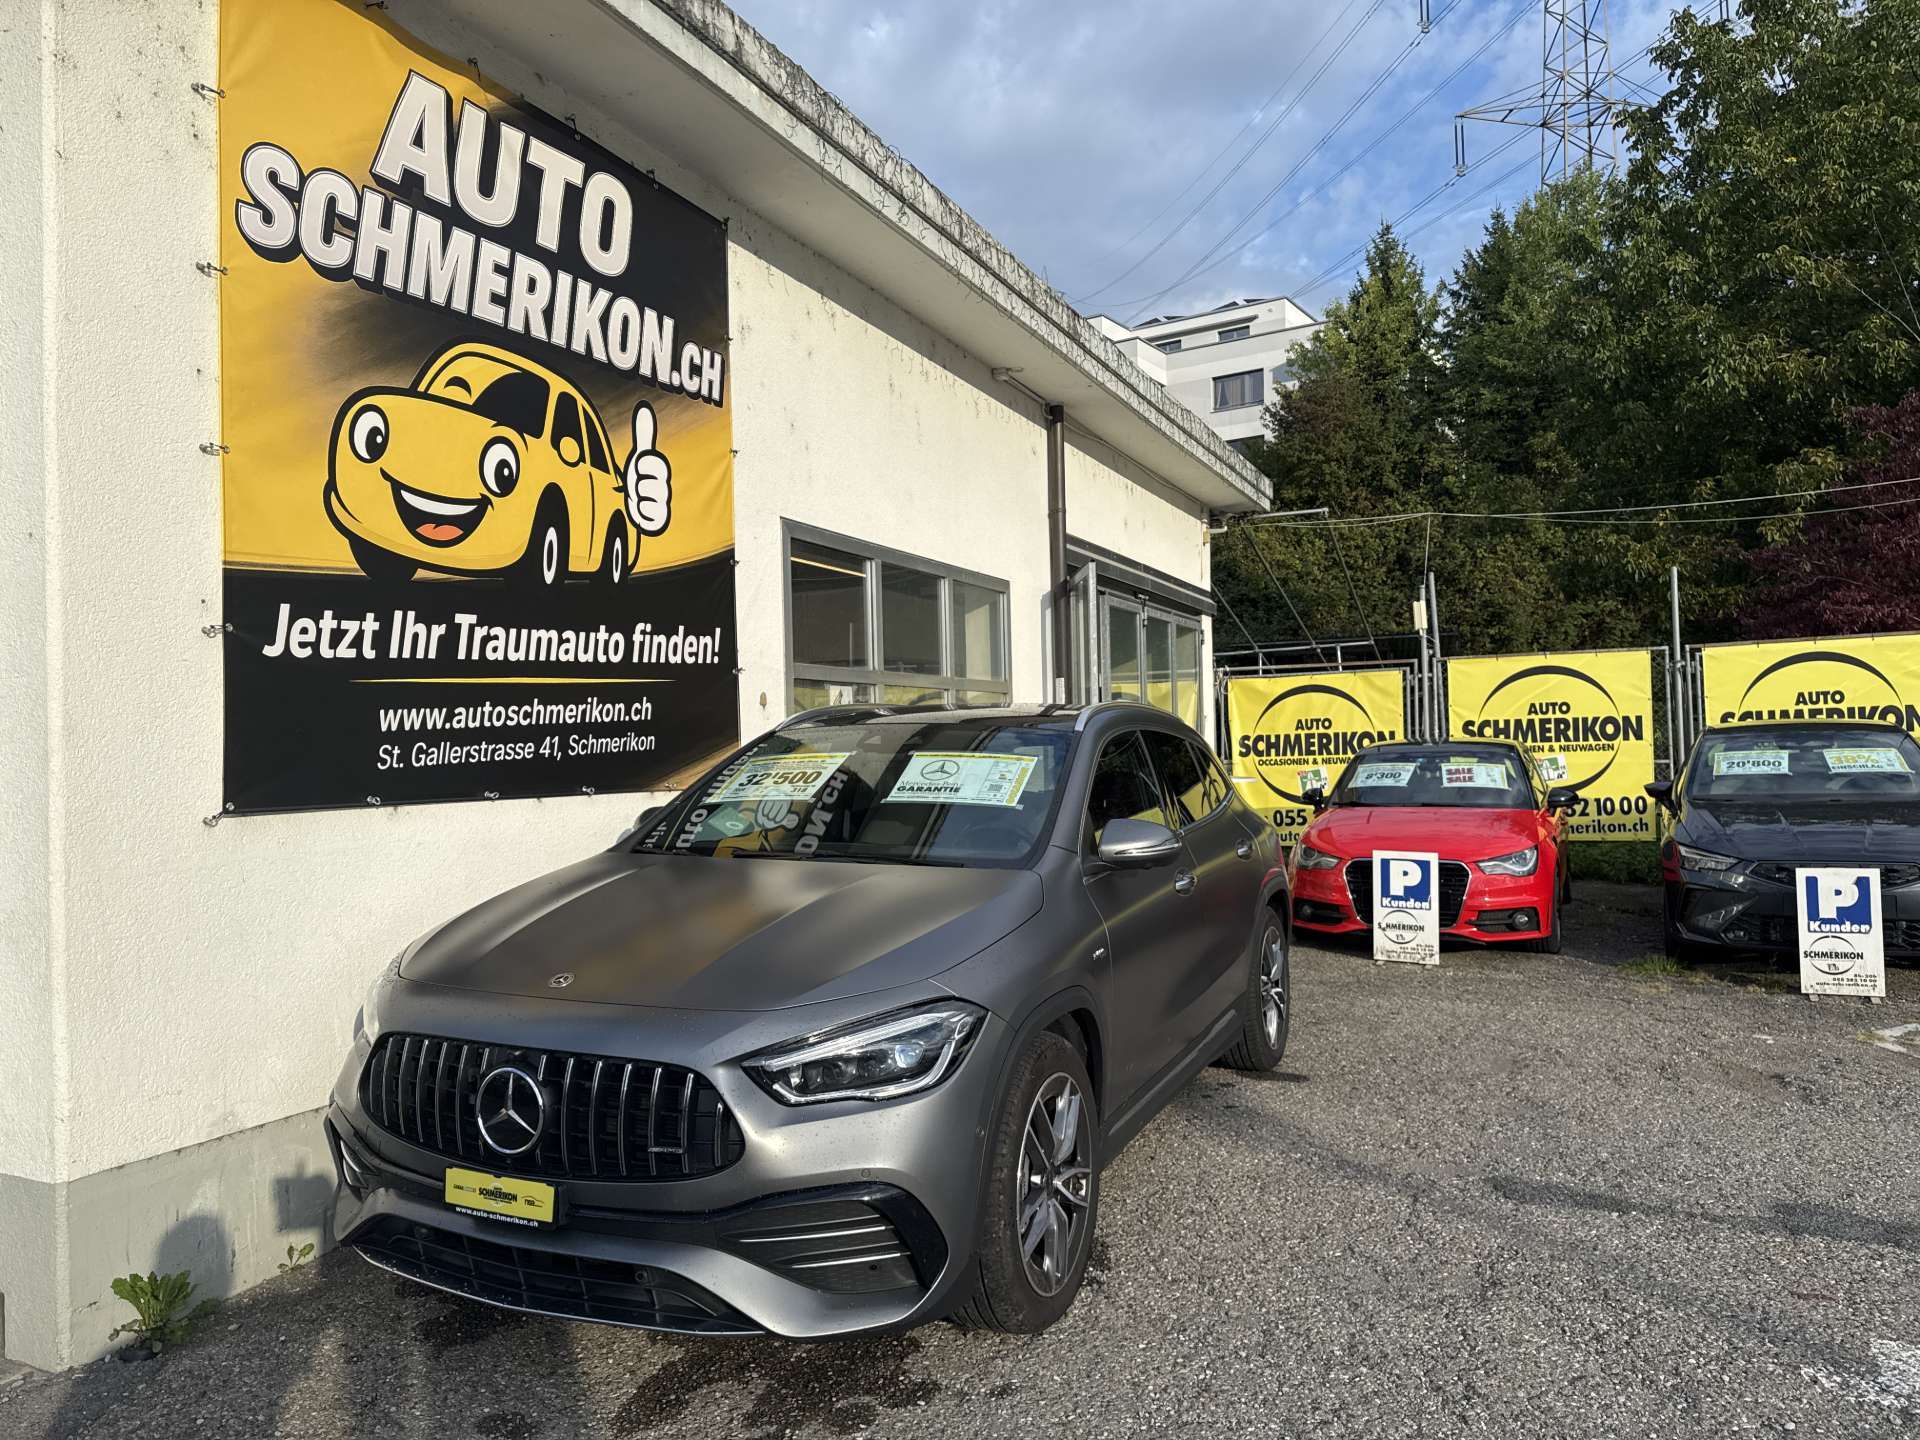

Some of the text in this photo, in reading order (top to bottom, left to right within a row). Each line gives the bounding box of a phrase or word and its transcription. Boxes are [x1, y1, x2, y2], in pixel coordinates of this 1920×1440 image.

[370, 69, 633, 277] AUTO
[238, 144, 723, 402] SCHMERIKON.CH
[262, 603, 721, 664] Jetzt Ihr Traumauto finden!
[1795, 691, 1845, 706] AUTO
[379, 697, 652, 732] www.autoschmerikon.ch
[1527, 701, 1571, 715] AUTO
[1295, 718, 1332, 731] AUTO
[1462, 715, 1643, 743] SCHMERIKON
[377, 733, 655, 770] St. Gallerstrasse 41, Schmerikon
[1548, 744, 1556, 752] &
[1559, 743, 1615, 752] NEUWAGEN
[1258, 758, 1309, 766] OCCASIONEN
[738, 770, 822, 787] 32'500
[896, 785, 961, 793] GARANTIE
[1273, 809, 1308, 827] 055
[1381, 897, 1431, 910] Kunden
[1809, 920, 1871, 933] Kunden
[1803, 950, 1864, 960] SCHMERIKON
[478, 1187, 518, 1203] SCHMERIKON
[455, 1206, 539, 1228] www.auto-schmerikon.ch
